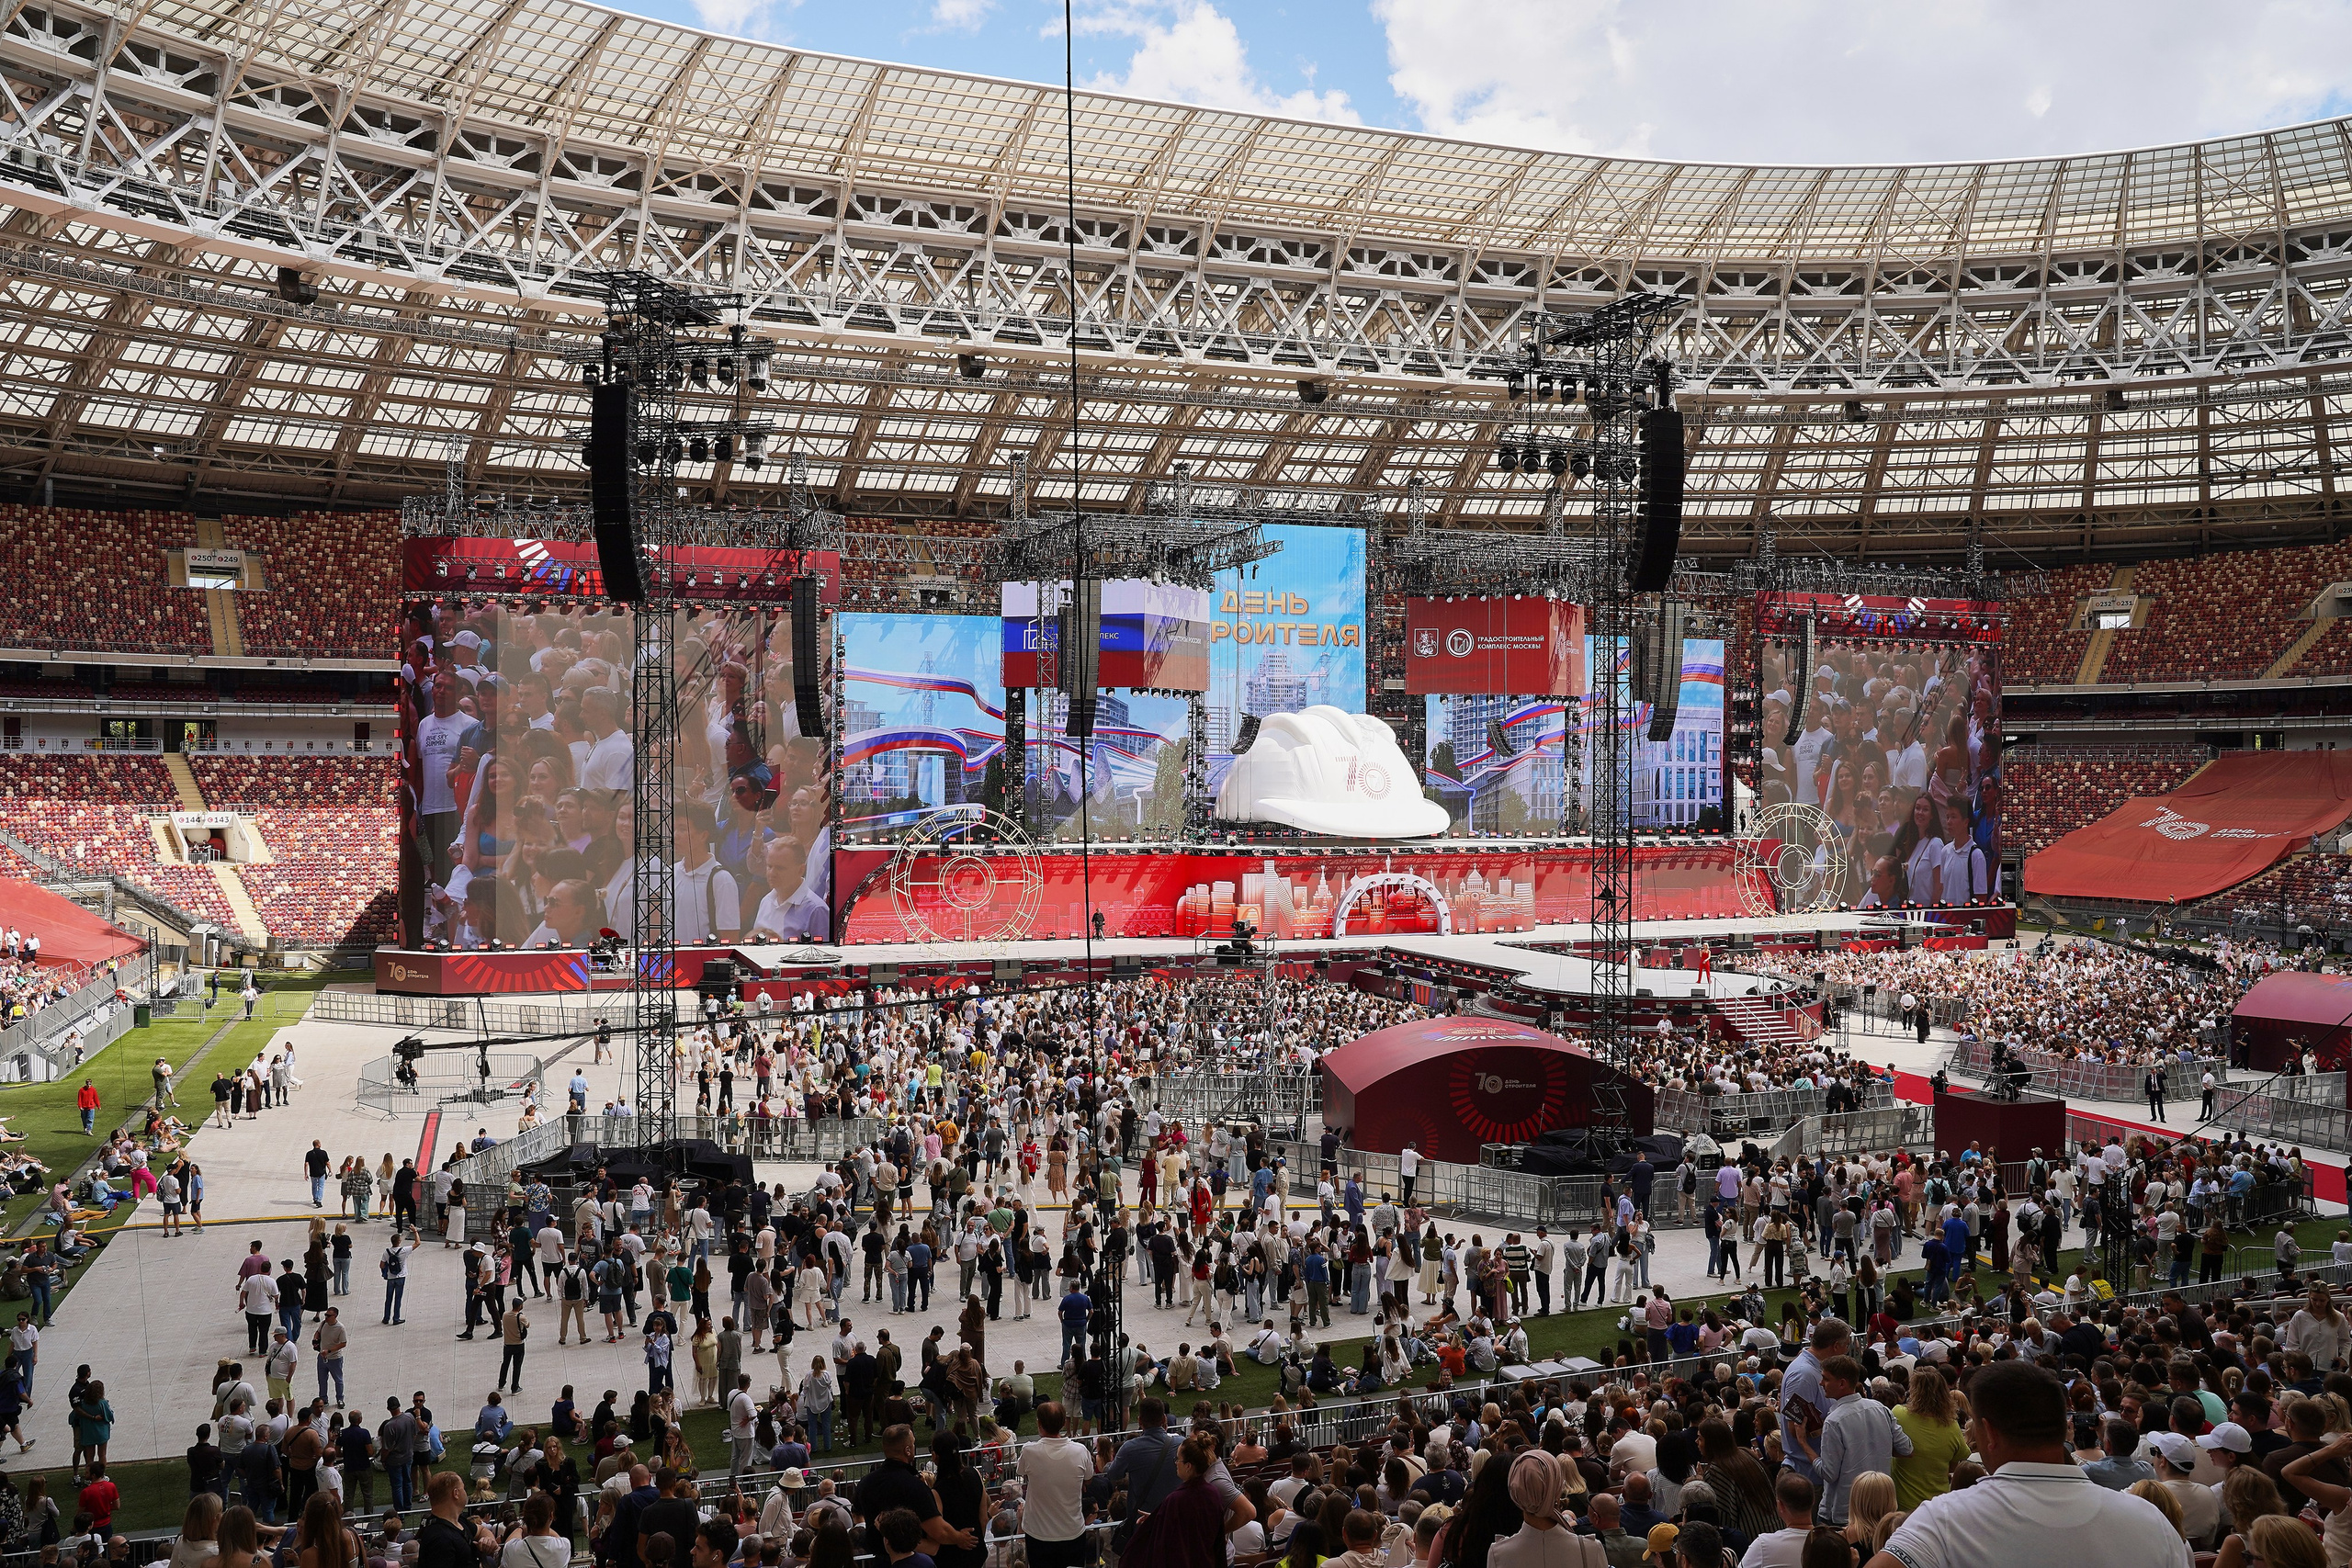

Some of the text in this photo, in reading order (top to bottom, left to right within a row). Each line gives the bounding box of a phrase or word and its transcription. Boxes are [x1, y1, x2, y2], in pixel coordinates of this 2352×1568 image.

[1219, 591, 1309, 615] ДЕНЬ
[1335, 755, 1392, 800] 70
[388, 962, 407, 982] 70
[1475, 1072, 1503, 1094] 70
